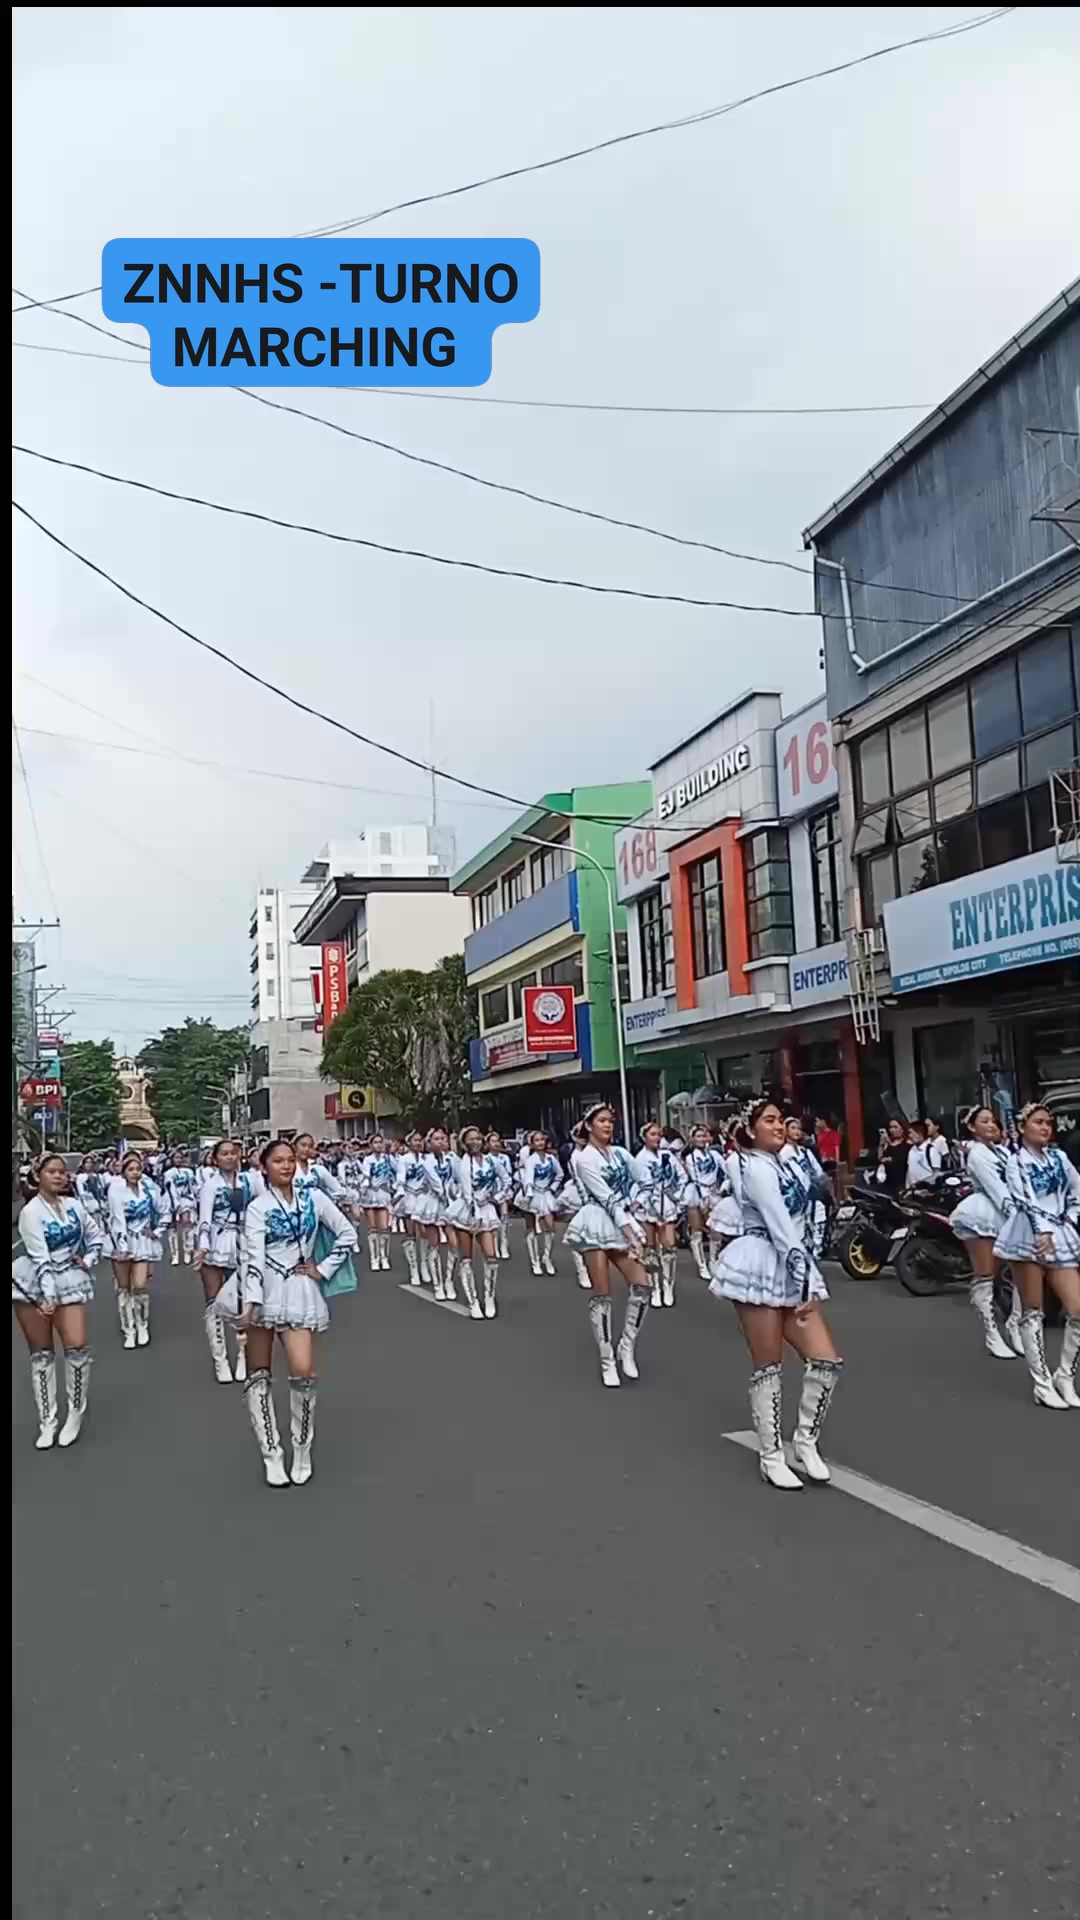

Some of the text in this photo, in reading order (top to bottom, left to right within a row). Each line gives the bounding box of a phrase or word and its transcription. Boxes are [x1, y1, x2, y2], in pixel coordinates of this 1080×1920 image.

[658, 744, 751, 819] EJ BUILDING
[783, 721, 837, 796] 16
[619, 824, 657, 885] 168
[949, 865, 1080, 951] ENTERPRIS
[36, 1084, 58, 1096] BPI
